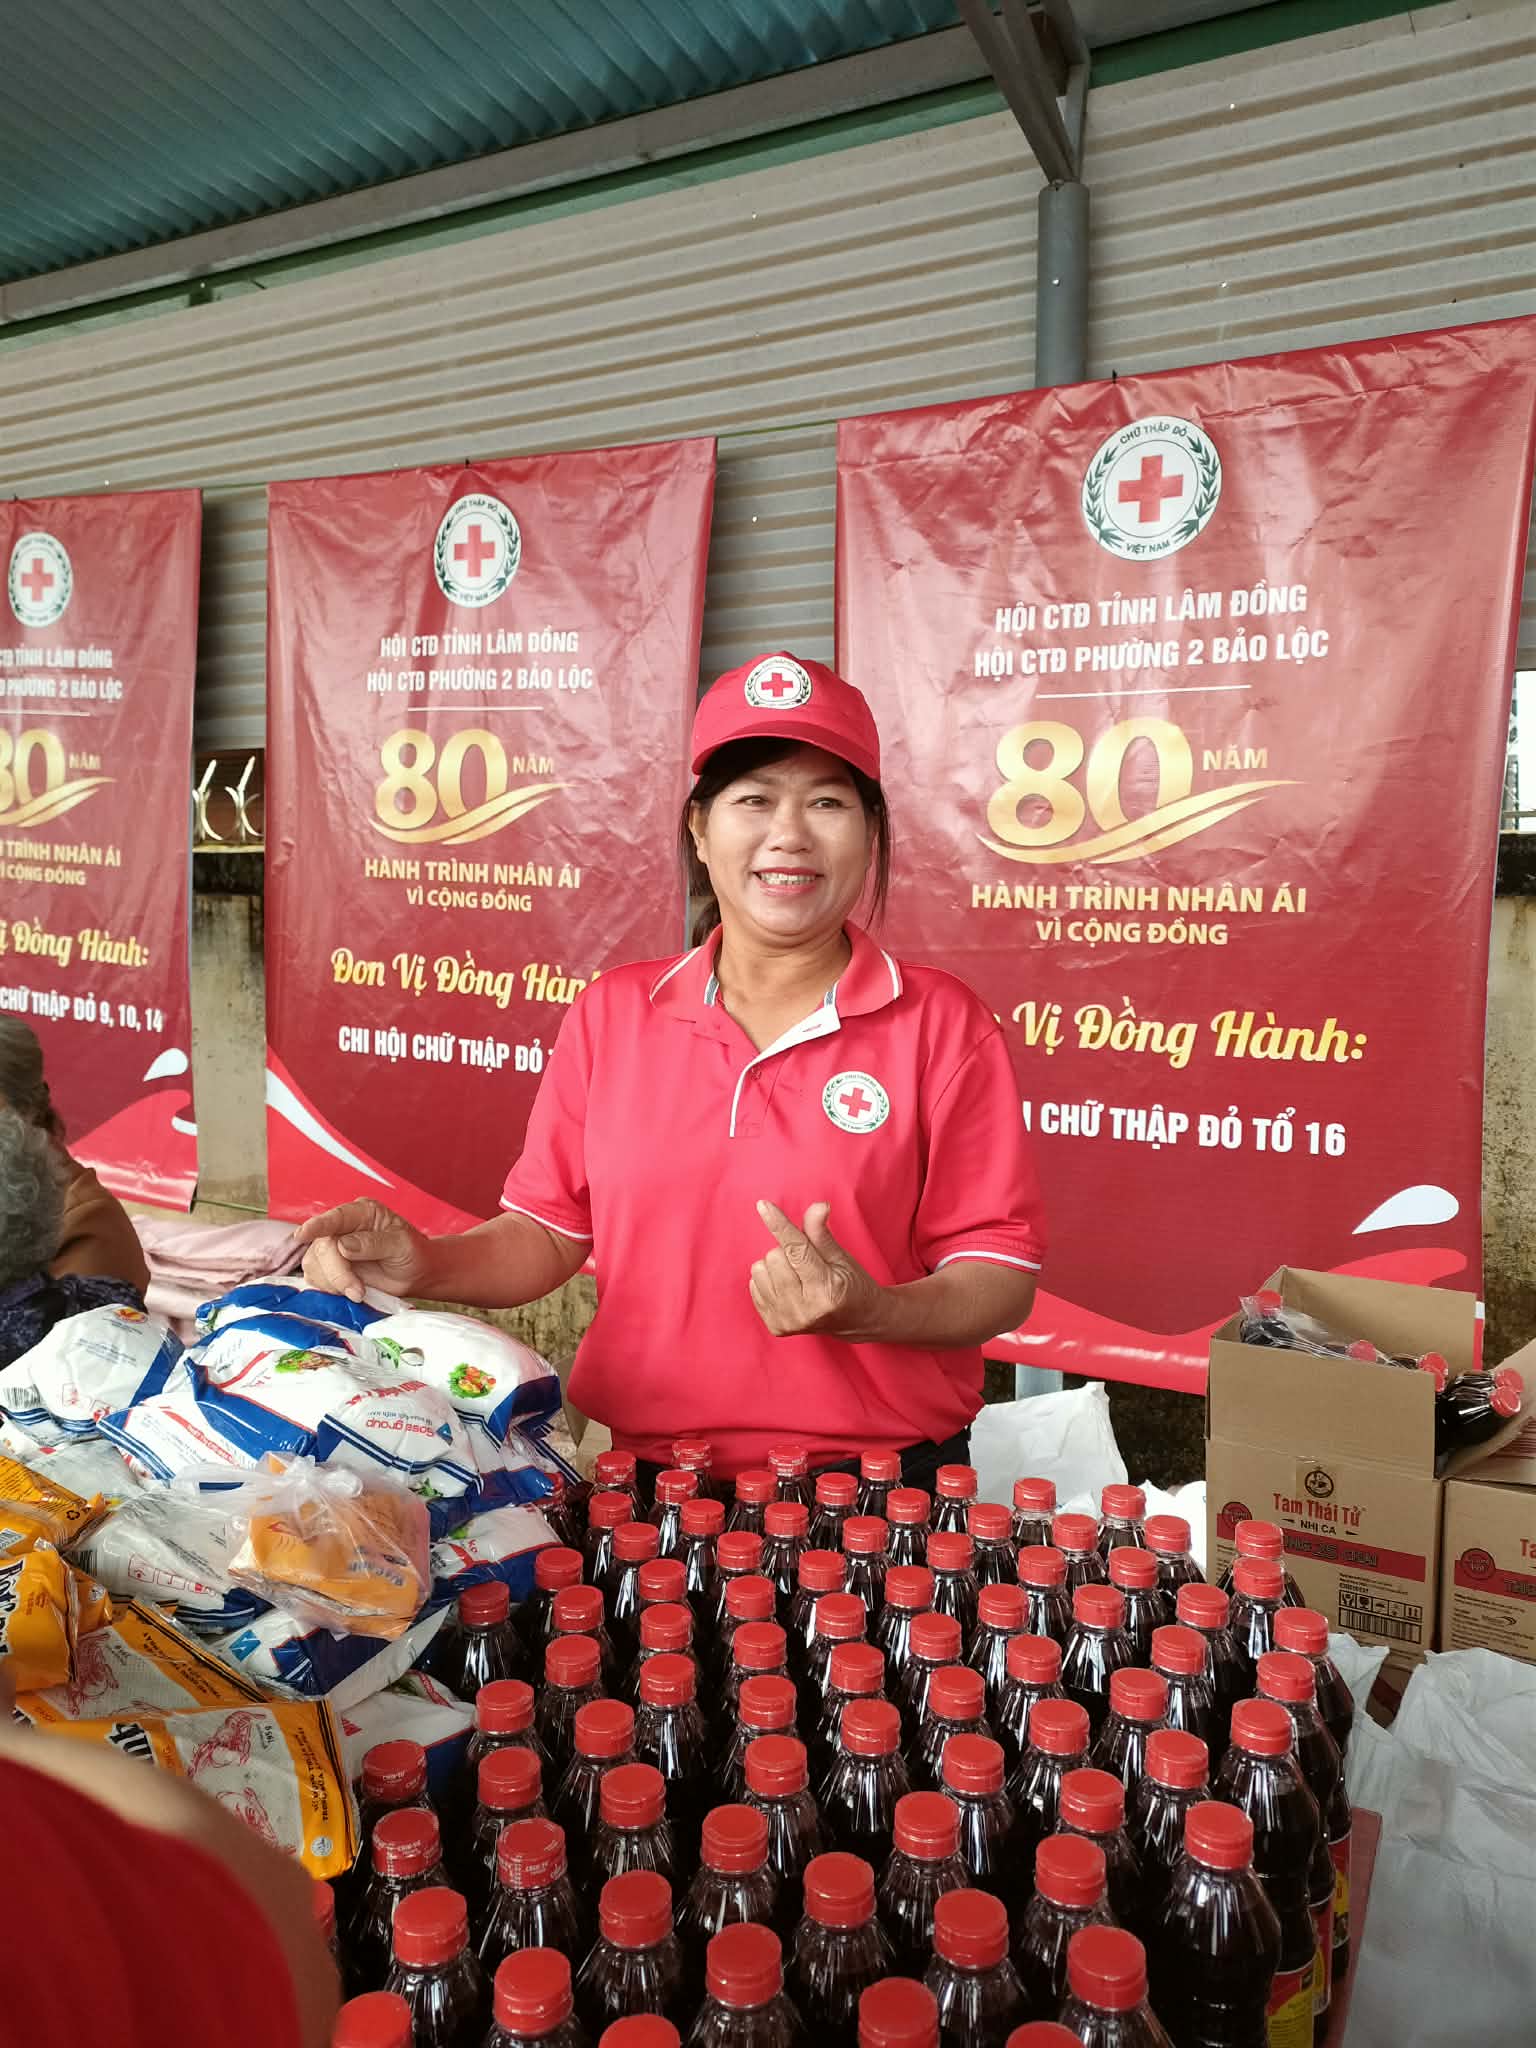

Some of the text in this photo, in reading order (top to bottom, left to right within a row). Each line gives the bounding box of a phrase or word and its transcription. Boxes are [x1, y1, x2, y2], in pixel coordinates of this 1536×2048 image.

[1148, 540, 1170, 552] NAM
[995, 578, 1308, 637] HỘI CTĐ TỈNH LÂM ĐỒNG
[380, 632, 407, 662] HỘI
[411, 634, 439, 657] CTĐ
[486, 628, 522, 655] LÂM
[974, 625, 1329, 682] HỘI CTĐ PHƯỜNG 2 BẢO LỘC
[59, 679, 69, 698] 2
[100, 676, 123, 703] LỘC
[367, 661, 593, 697] HỘI CTĐ PHƯỜNG 2 BẢO LỘC
[375, 728, 555, 830] 80 NĂM
[987, 716, 1268, 847] 80 NĂM
[8, 862, 42, 884] CỘNG
[364, 855, 581, 889] HÀNH TRÌNH NHÂN ÁI
[407, 885, 424, 906] VÌ
[427, 886, 478, 912] CỘNG
[971, 879, 1307, 913] HÀNH TRÌNH NHÂN ÁI
[12, 916, 73, 967] Đồng
[78, 927, 150, 967] Hành:
[1036, 916, 1229, 948] VÌ CỘNG ĐỒNG
[392, 952, 428, 997] Vị
[433, 949, 515, 1009] Đồng
[522, 963, 601, 1005] Hàn
[32, 989, 71, 1022] THẬP
[74, 991, 97, 1022] ĐỎ
[99, 1001, 115, 1028] 9,
[118, 1004, 141, 1032] 10,
[145, 1008, 164, 1033] 14
[338, 1025, 543, 1074] CHI HỘI CHỮ THẬP ĐỎ
[1012, 996, 1367, 1069] Vị Đồng Hành:
[1040, 1099, 1105, 1138] CHỮ
[1109, 1103, 1189, 1150] THẬP
[1198, 1105, 1243, 1149] ĐỎ
[1252, 1106, 1297, 1153] TỔ
[1305, 1121, 1346, 1156] 16
[1273, 1492, 1303, 1516] Tam
[1306, 1499, 1339, 1523] Thái
[1321, 1521, 1337, 1535] CA
